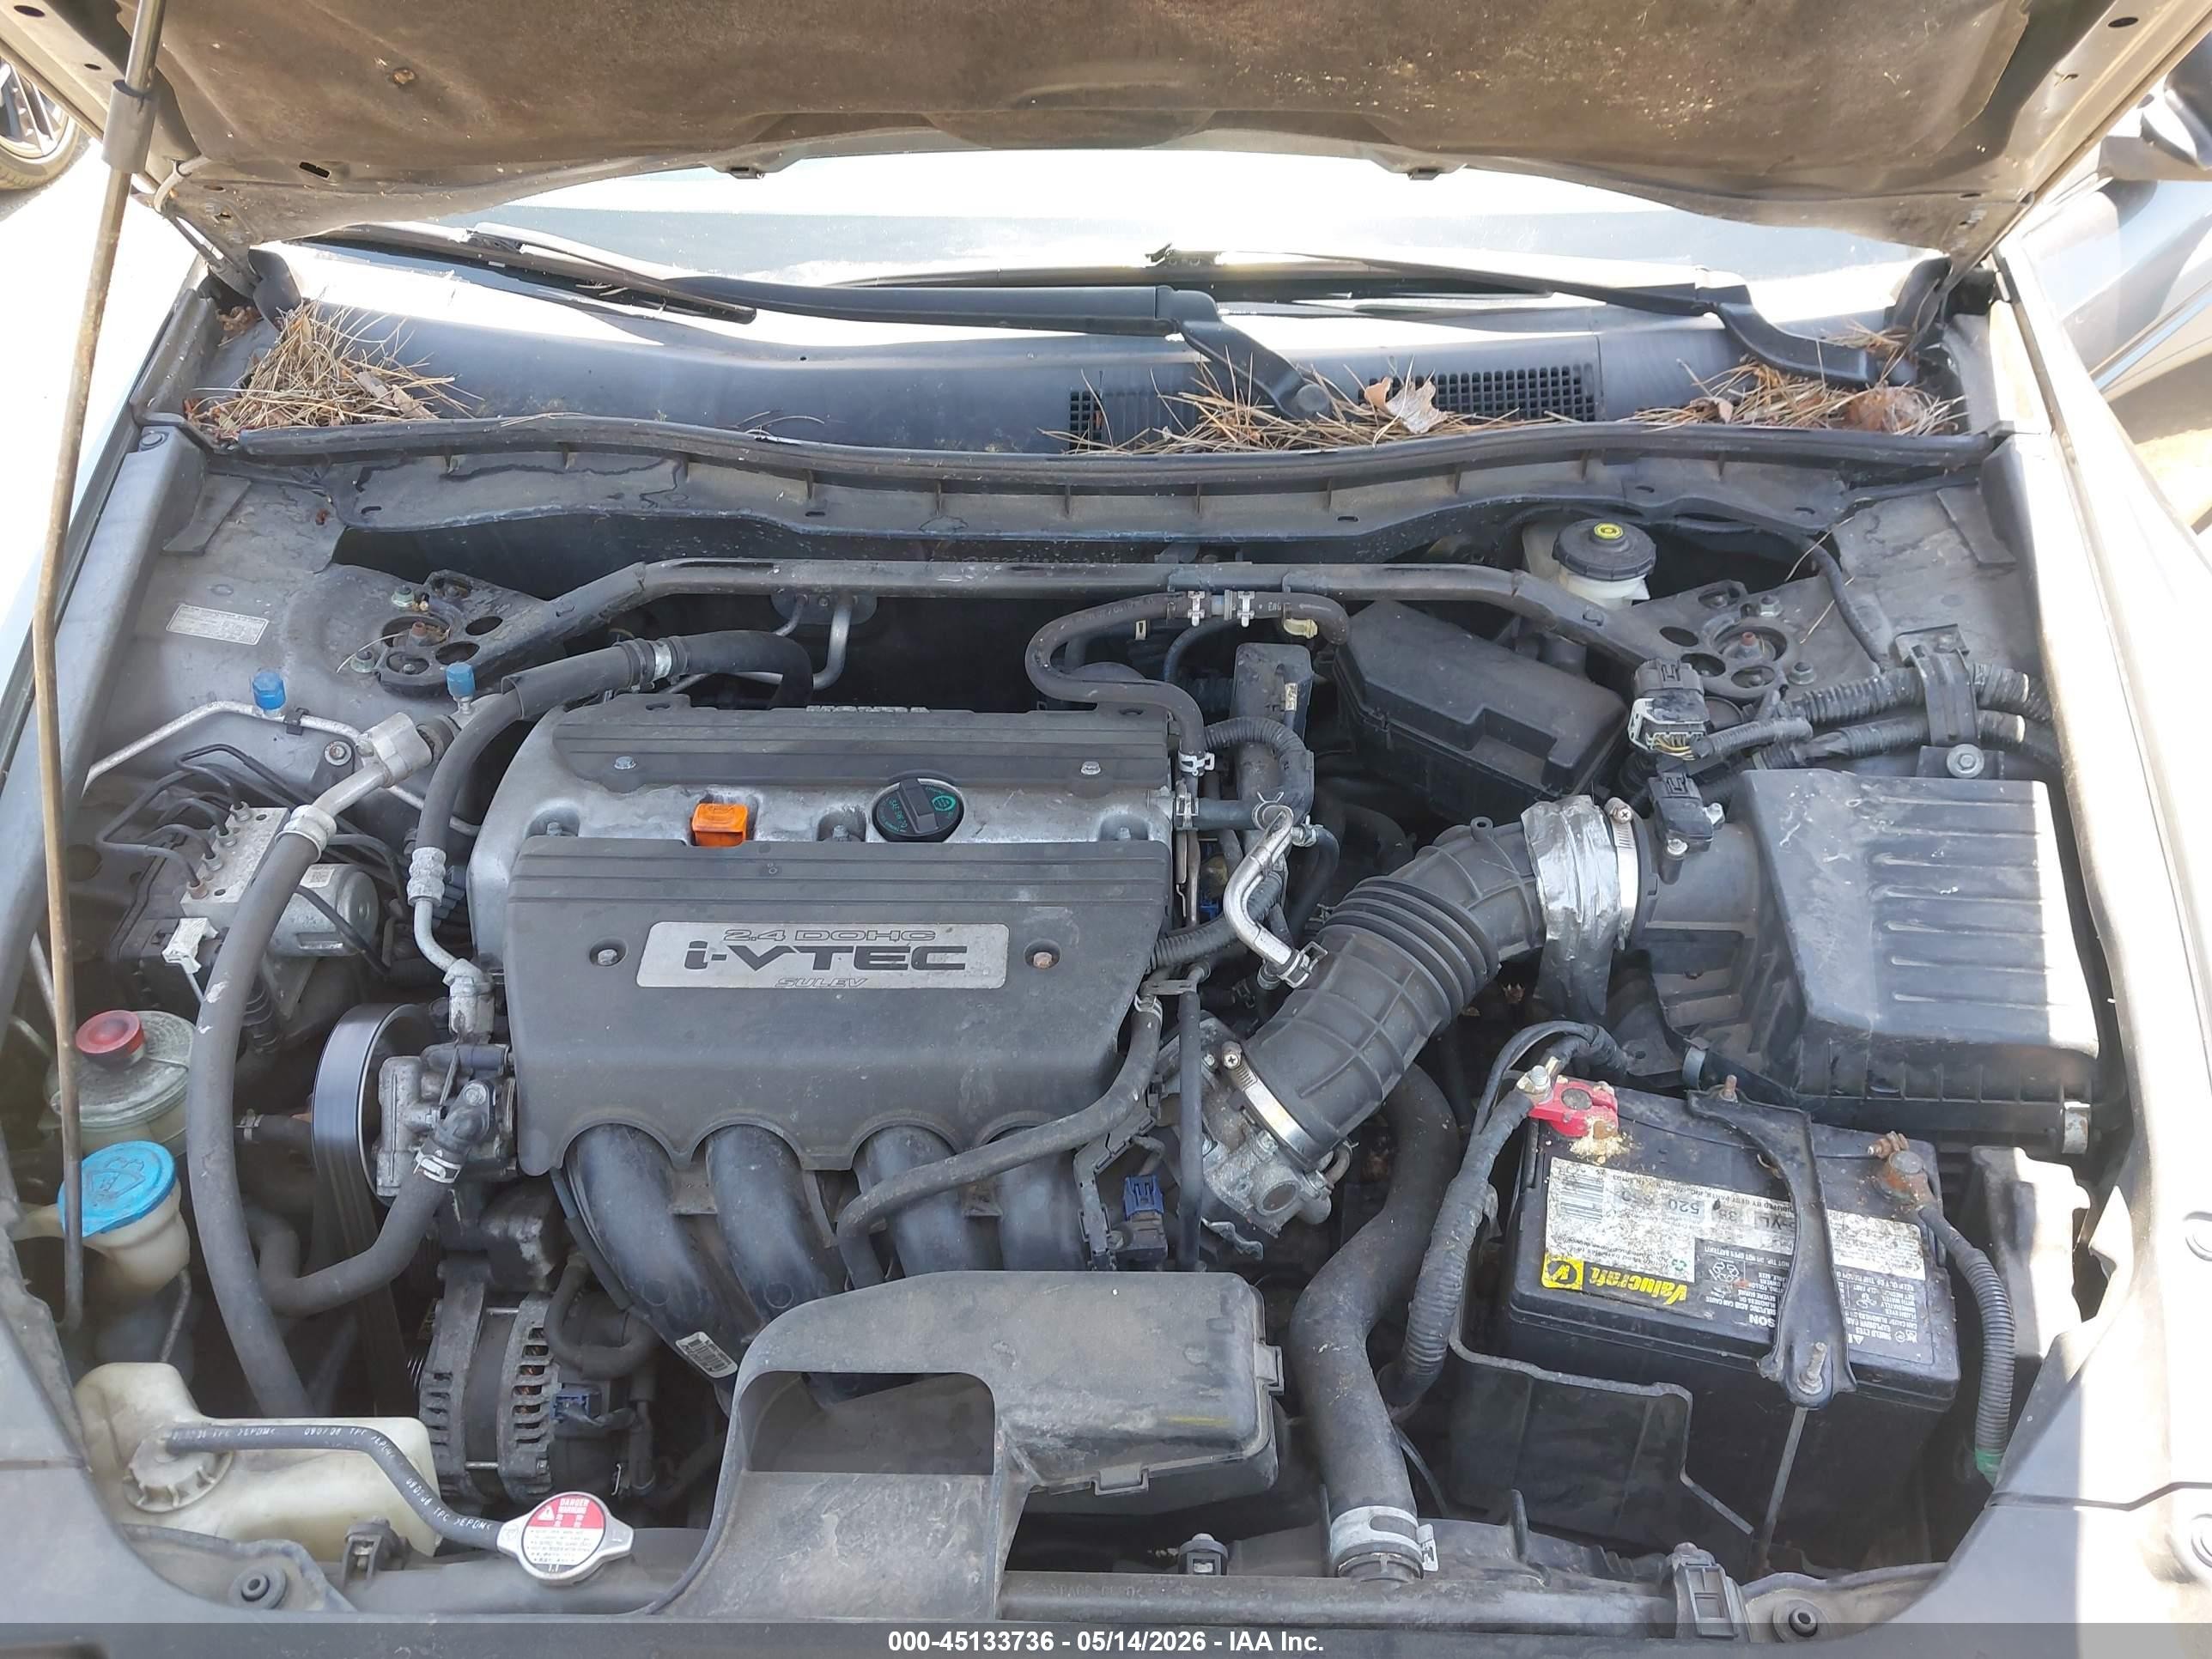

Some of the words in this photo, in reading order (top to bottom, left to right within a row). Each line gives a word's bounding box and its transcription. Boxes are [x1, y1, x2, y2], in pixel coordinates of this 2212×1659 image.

[722, 929, 787, 942] 2.4
[793, 929, 937, 942] DOHC
[684, 940, 968, 972] i-VTEC
[774, 976, 870, 988] SULEV
[1668, 1198, 1700, 1215] 520
[1589, 1267, 1688, 1306] Valucraft
[1748, 1314, 1777, 1328] SON
[559, 1497, 590, 1506] DANGER
